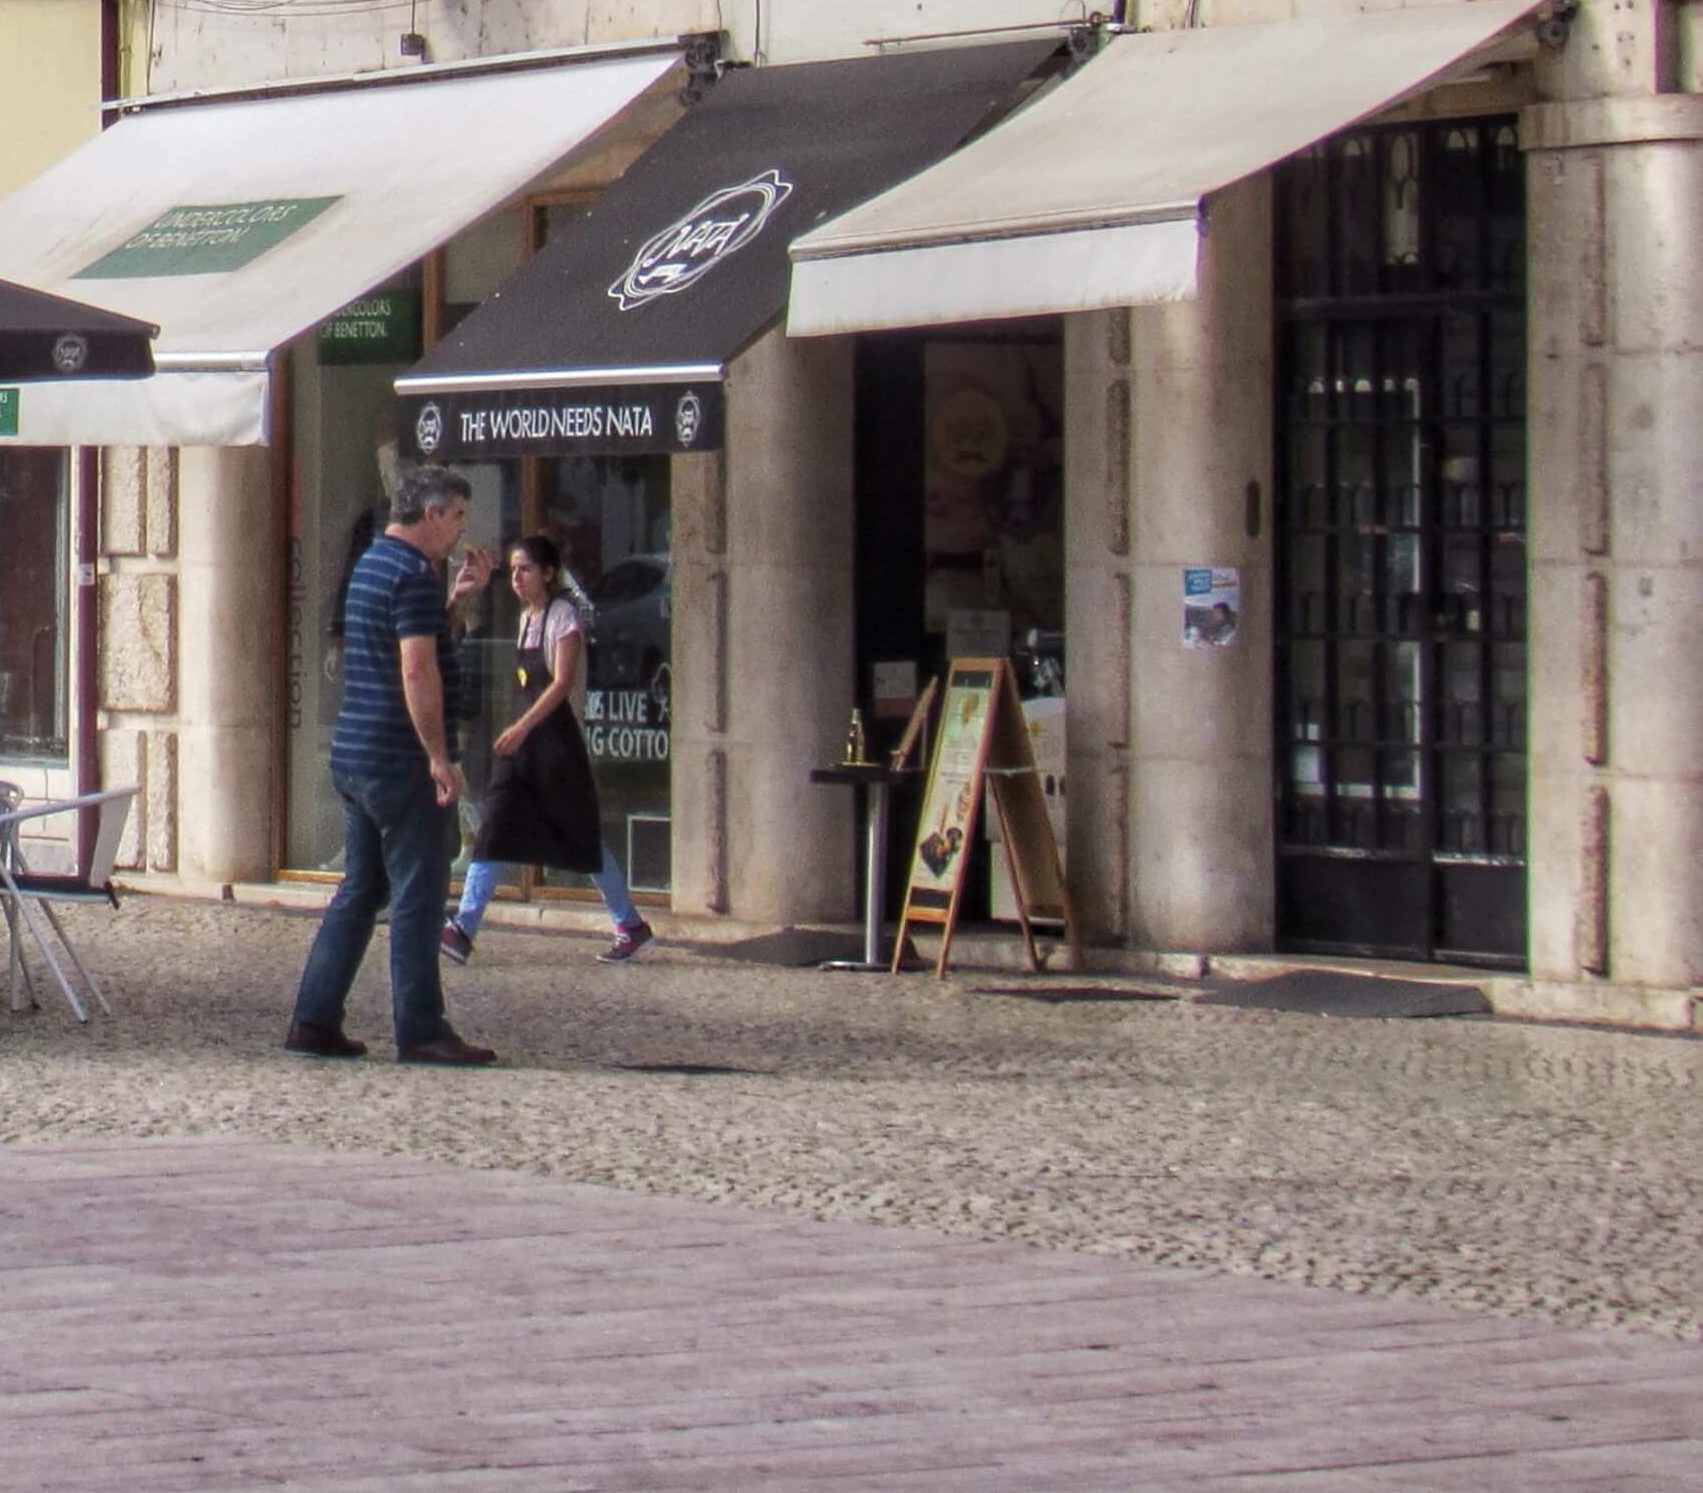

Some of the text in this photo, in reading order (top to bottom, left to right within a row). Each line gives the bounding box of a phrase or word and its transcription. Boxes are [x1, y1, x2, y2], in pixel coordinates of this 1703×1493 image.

[461, 411, 486, 442] THE
[490, 408, 549, 440] WORLD
[551, 406, 602, 438] NEEDS
[605, 405, 653, 436] NATA
[609, 691, 648, 723] LIVE
